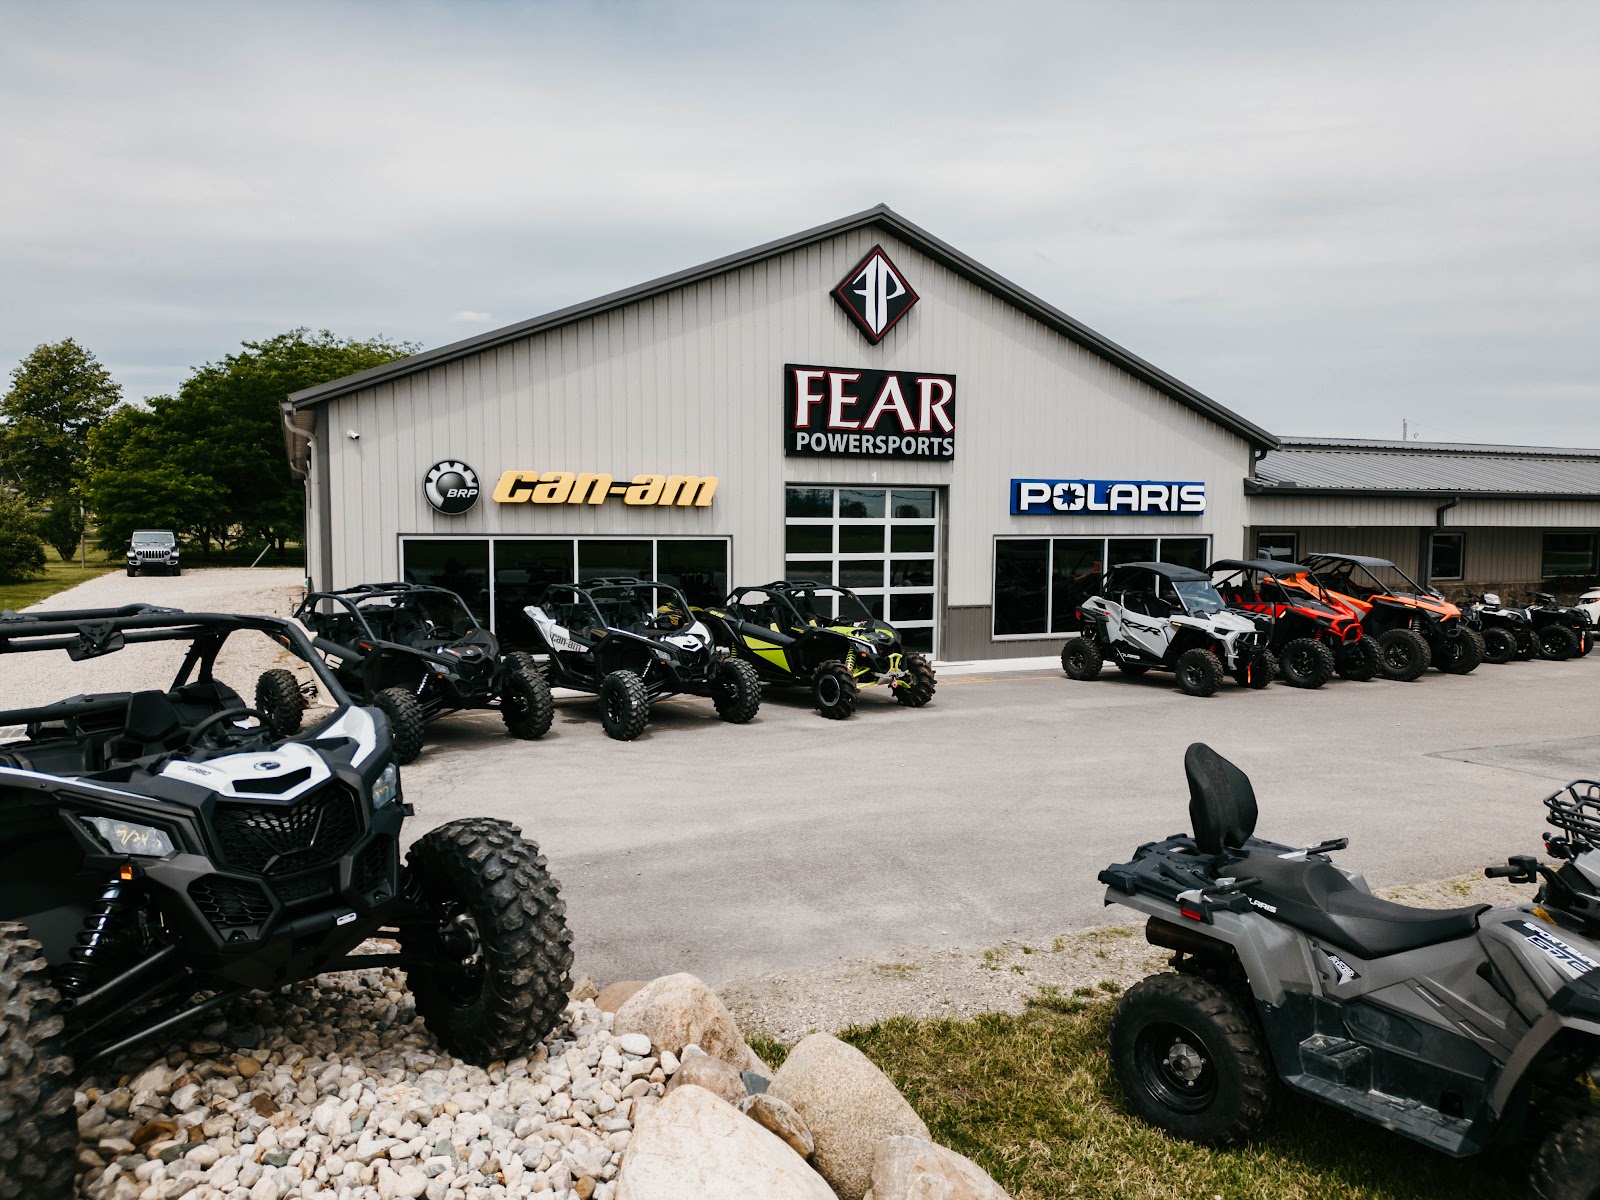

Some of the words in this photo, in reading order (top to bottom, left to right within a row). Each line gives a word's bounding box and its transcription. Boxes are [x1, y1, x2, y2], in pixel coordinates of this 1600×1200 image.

[794, 368, 955, 434] FEAR
[796, 432, 954, 456] POWERSPORTS
[492, 470, 719, 507] can-am
[871, 471, 877, 482] 1
[446, 488, 478, 499] BRP
[1020, 482, 1207, 512] POLARIS
[184, 765, 212, 776] TURBO
[1247, 897, 1278, 913] LARIS
[1522, 922, 1600, 968] SPORTSMA
